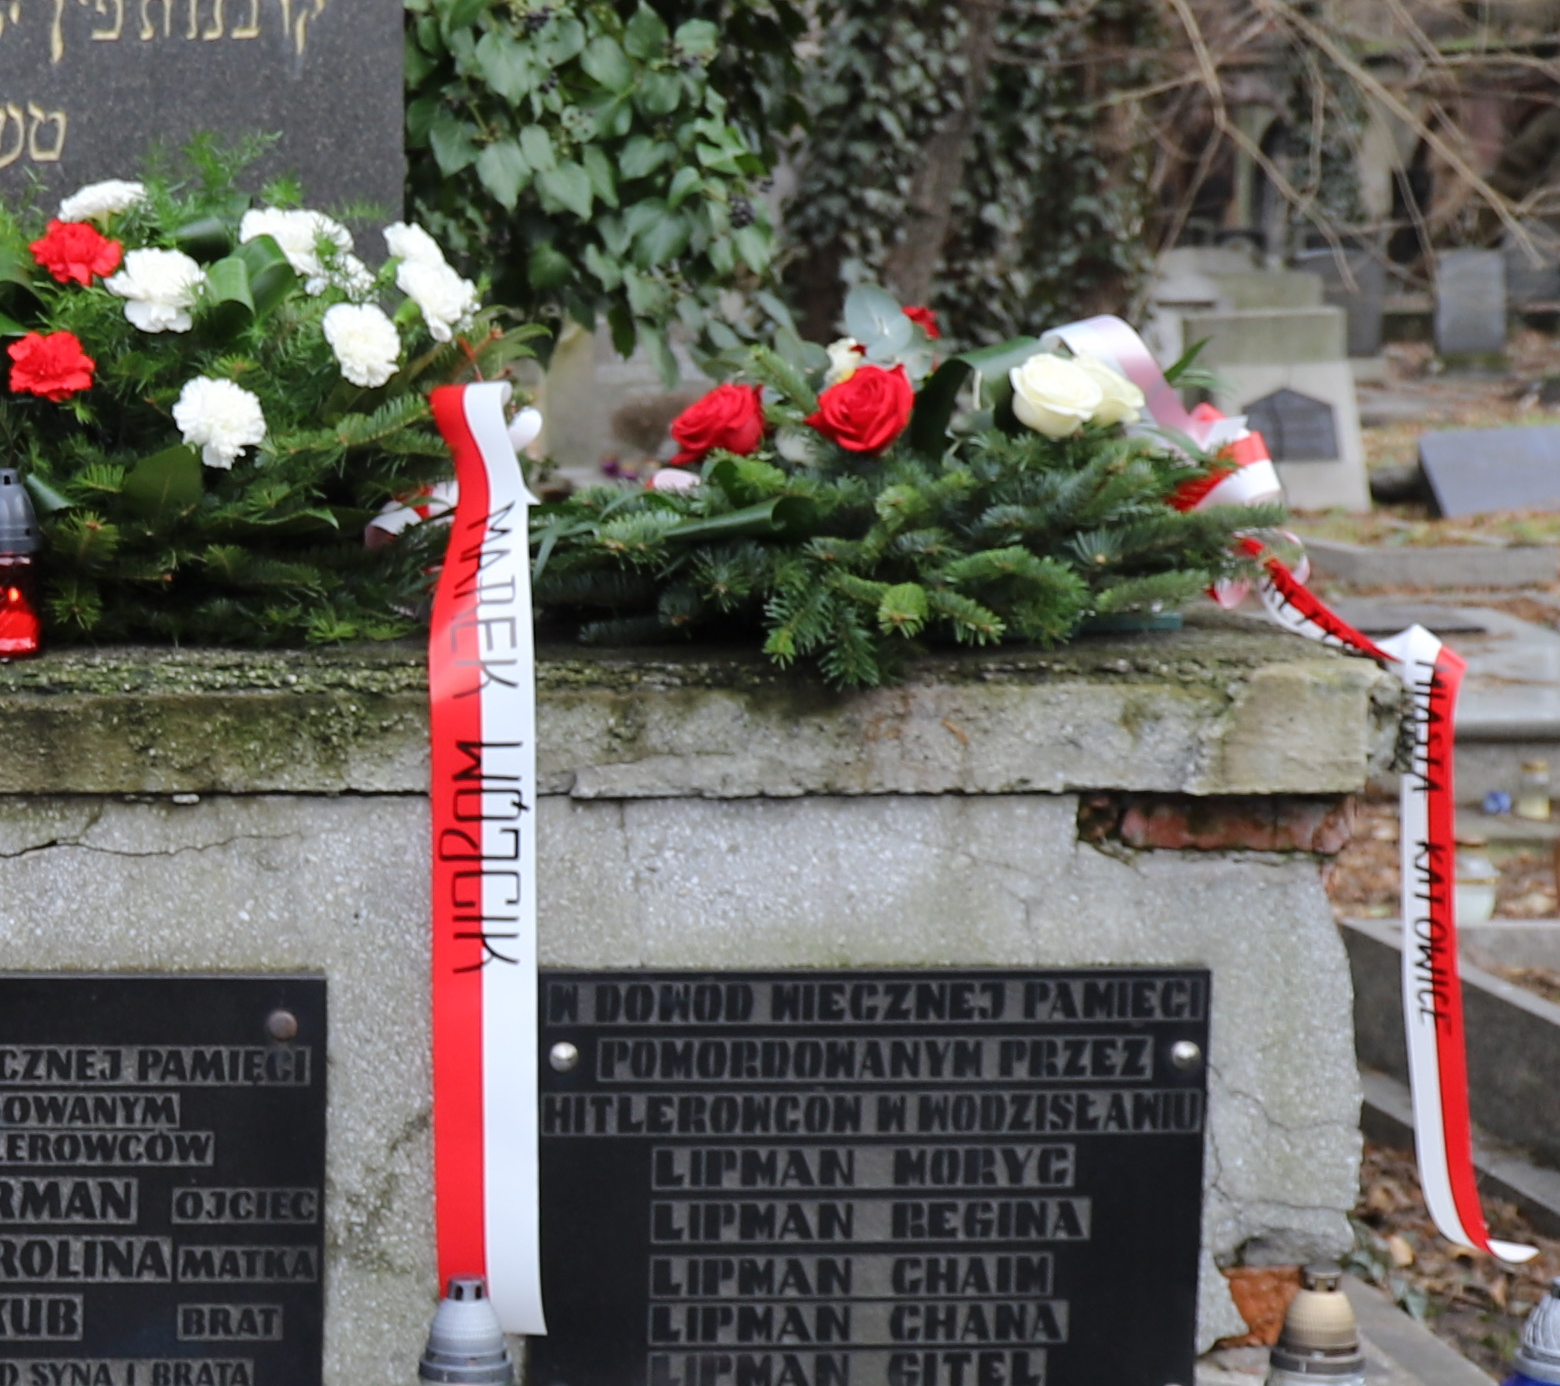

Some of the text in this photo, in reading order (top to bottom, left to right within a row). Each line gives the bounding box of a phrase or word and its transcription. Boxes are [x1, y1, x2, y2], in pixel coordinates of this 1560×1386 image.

[437, 499, 531, 975] MAREK WÓJCIK
[1413, 839, 1454, 1037] KATOWICE
[547, 983, 578, 1023] W
[770, 982, 1006, 1023] WIECZNEJ
[600, 1037, 1149, 1080] POMORDOWANYM PRZEZ
[877, 1094, 907, 1133] W
[918, 1091, 1199, 1132] WODZISŁAWIU
[653, 1147, 1072, 1189] LIPMAN MORYC
[175, 1189, 316, 1222] OJCIEC
[653, 1201, 1084, 1242] LIPMAN REGINA
[180, 1248, 316, 1281] MATKA
[651, 1256, 1050, 1297] LIPMAN CHAIM
[180, 1307, 280, 1339] BRAT
[650, 1302, 1063, 1344] LIPMAN CHANA
